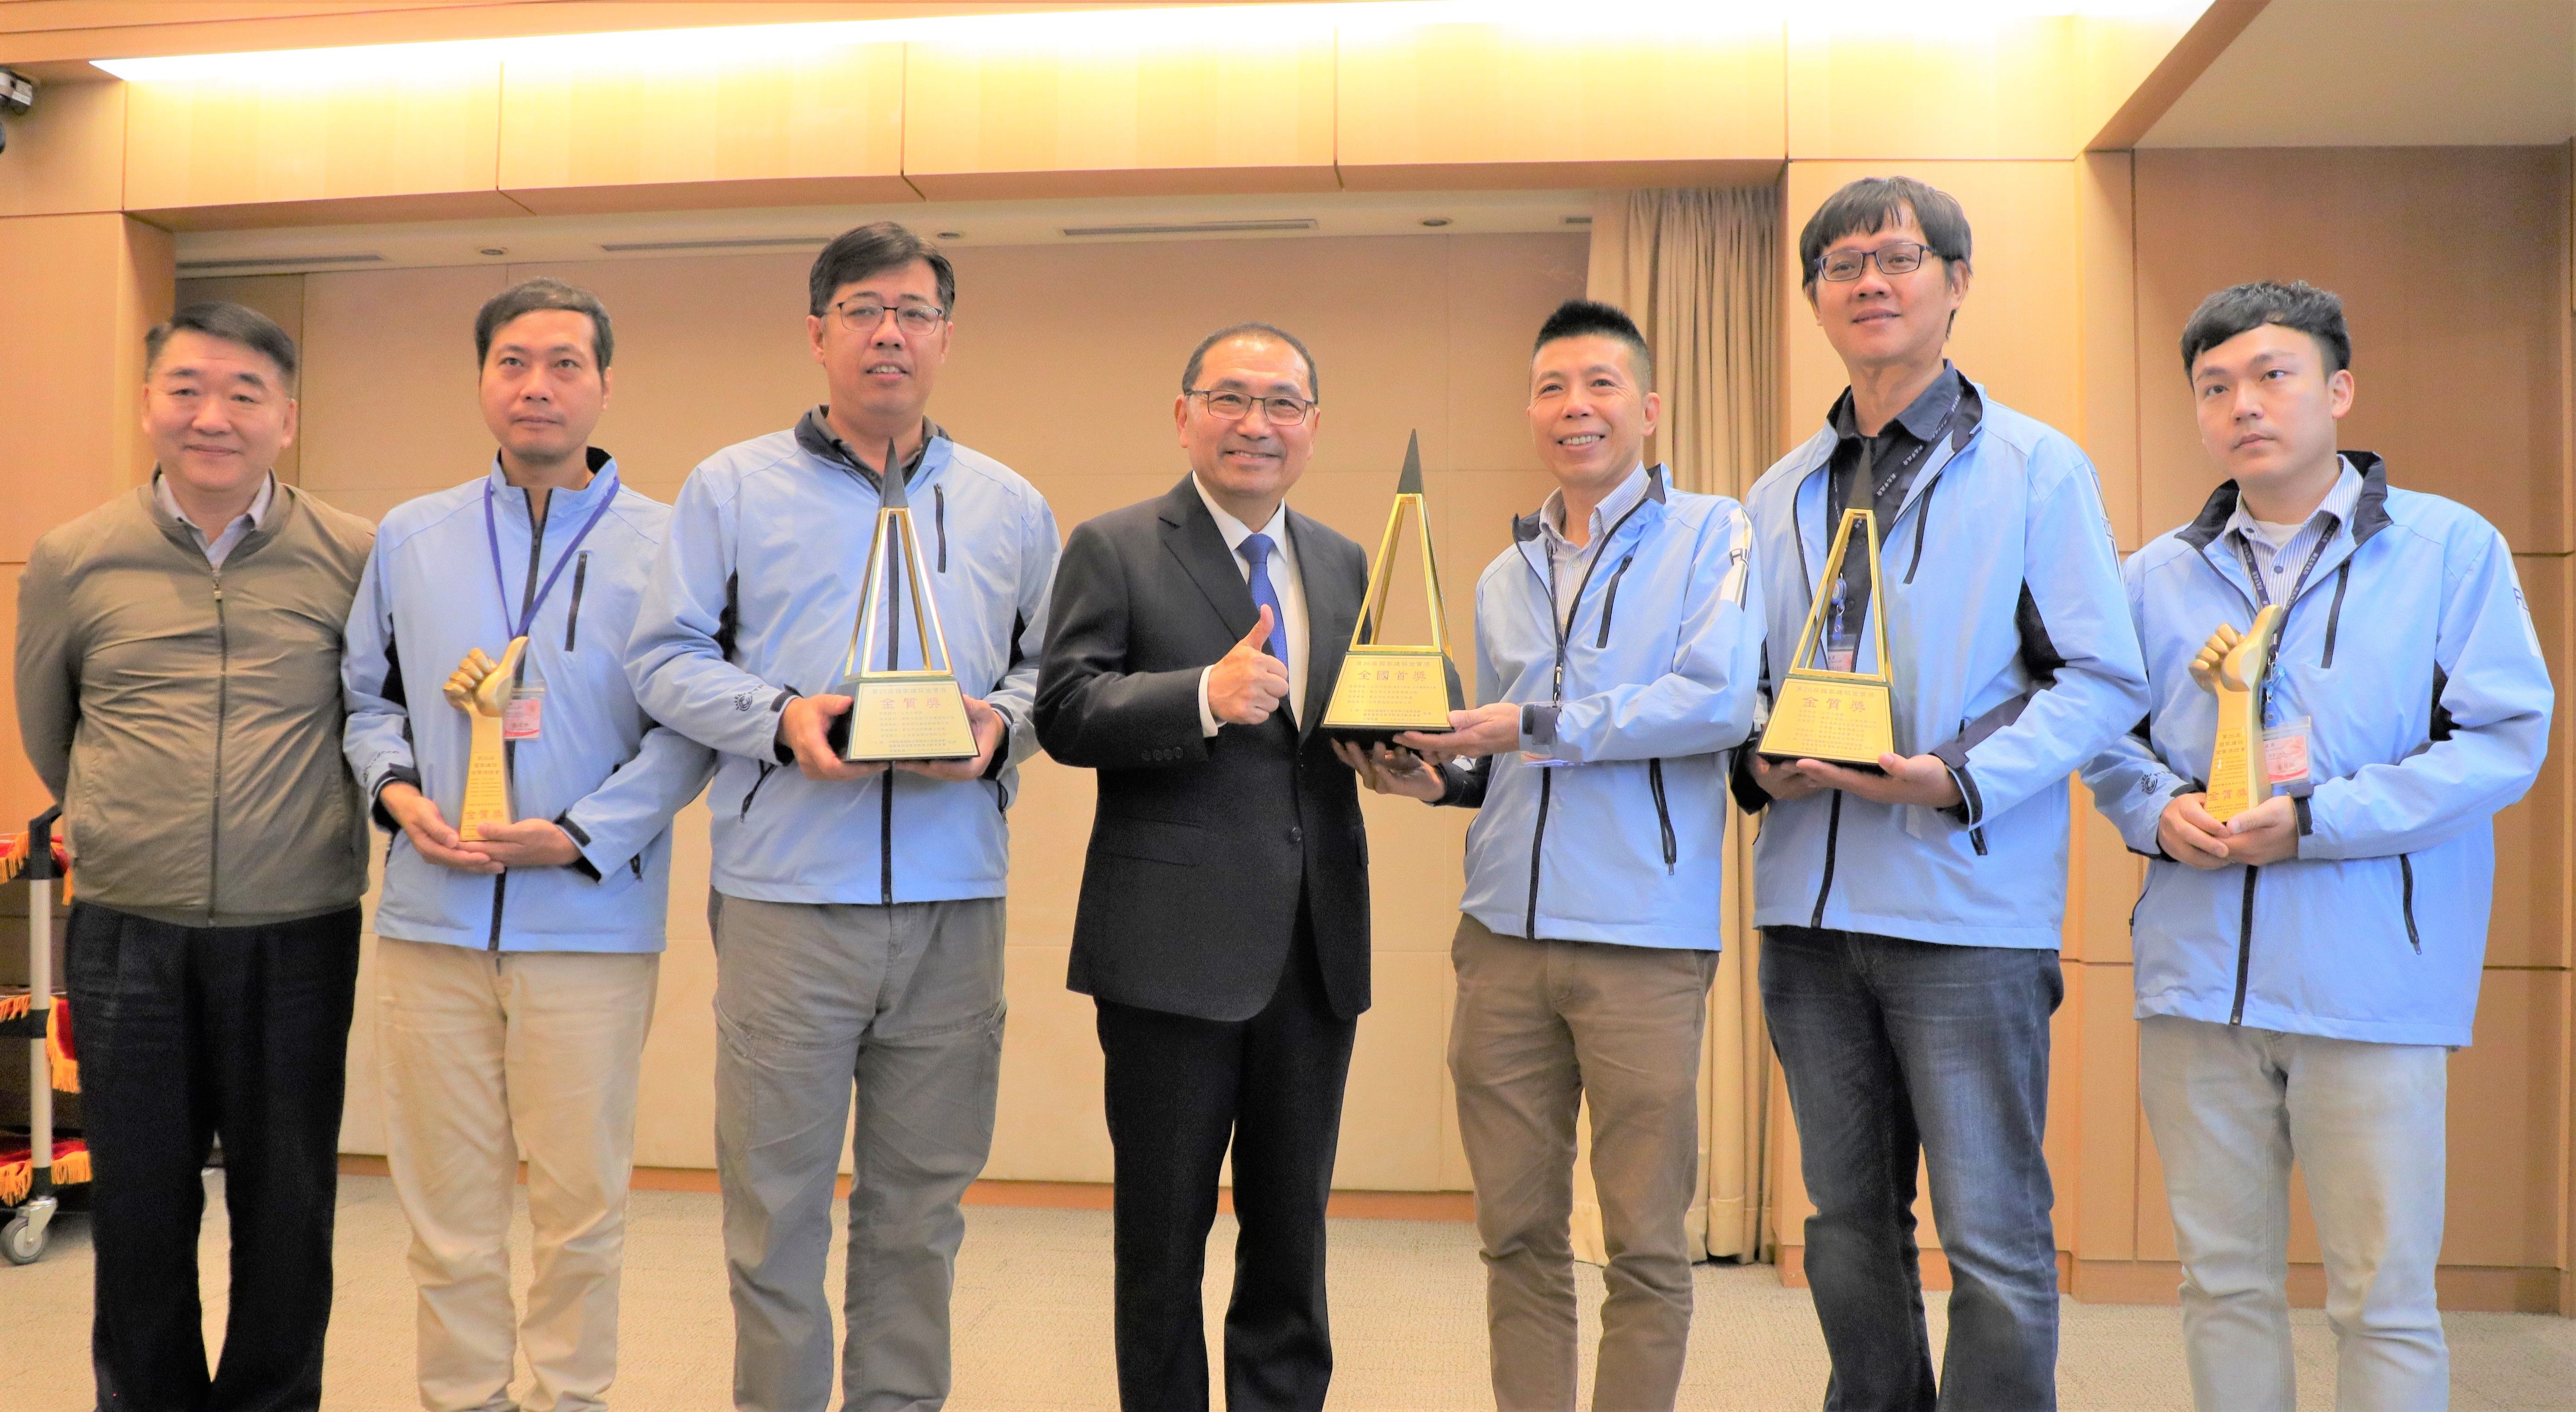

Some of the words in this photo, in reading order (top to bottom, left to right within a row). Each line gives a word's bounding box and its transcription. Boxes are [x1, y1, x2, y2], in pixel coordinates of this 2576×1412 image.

[1358, 670, 1427, 682] 全國首獎
[880, 697, 942, 710] 金質獎
[1802, 696, 1866, 712] 金質獎
[2208, 788, 2247, 802] 金質獎
[465, 809, 503, 820] 金質獎
